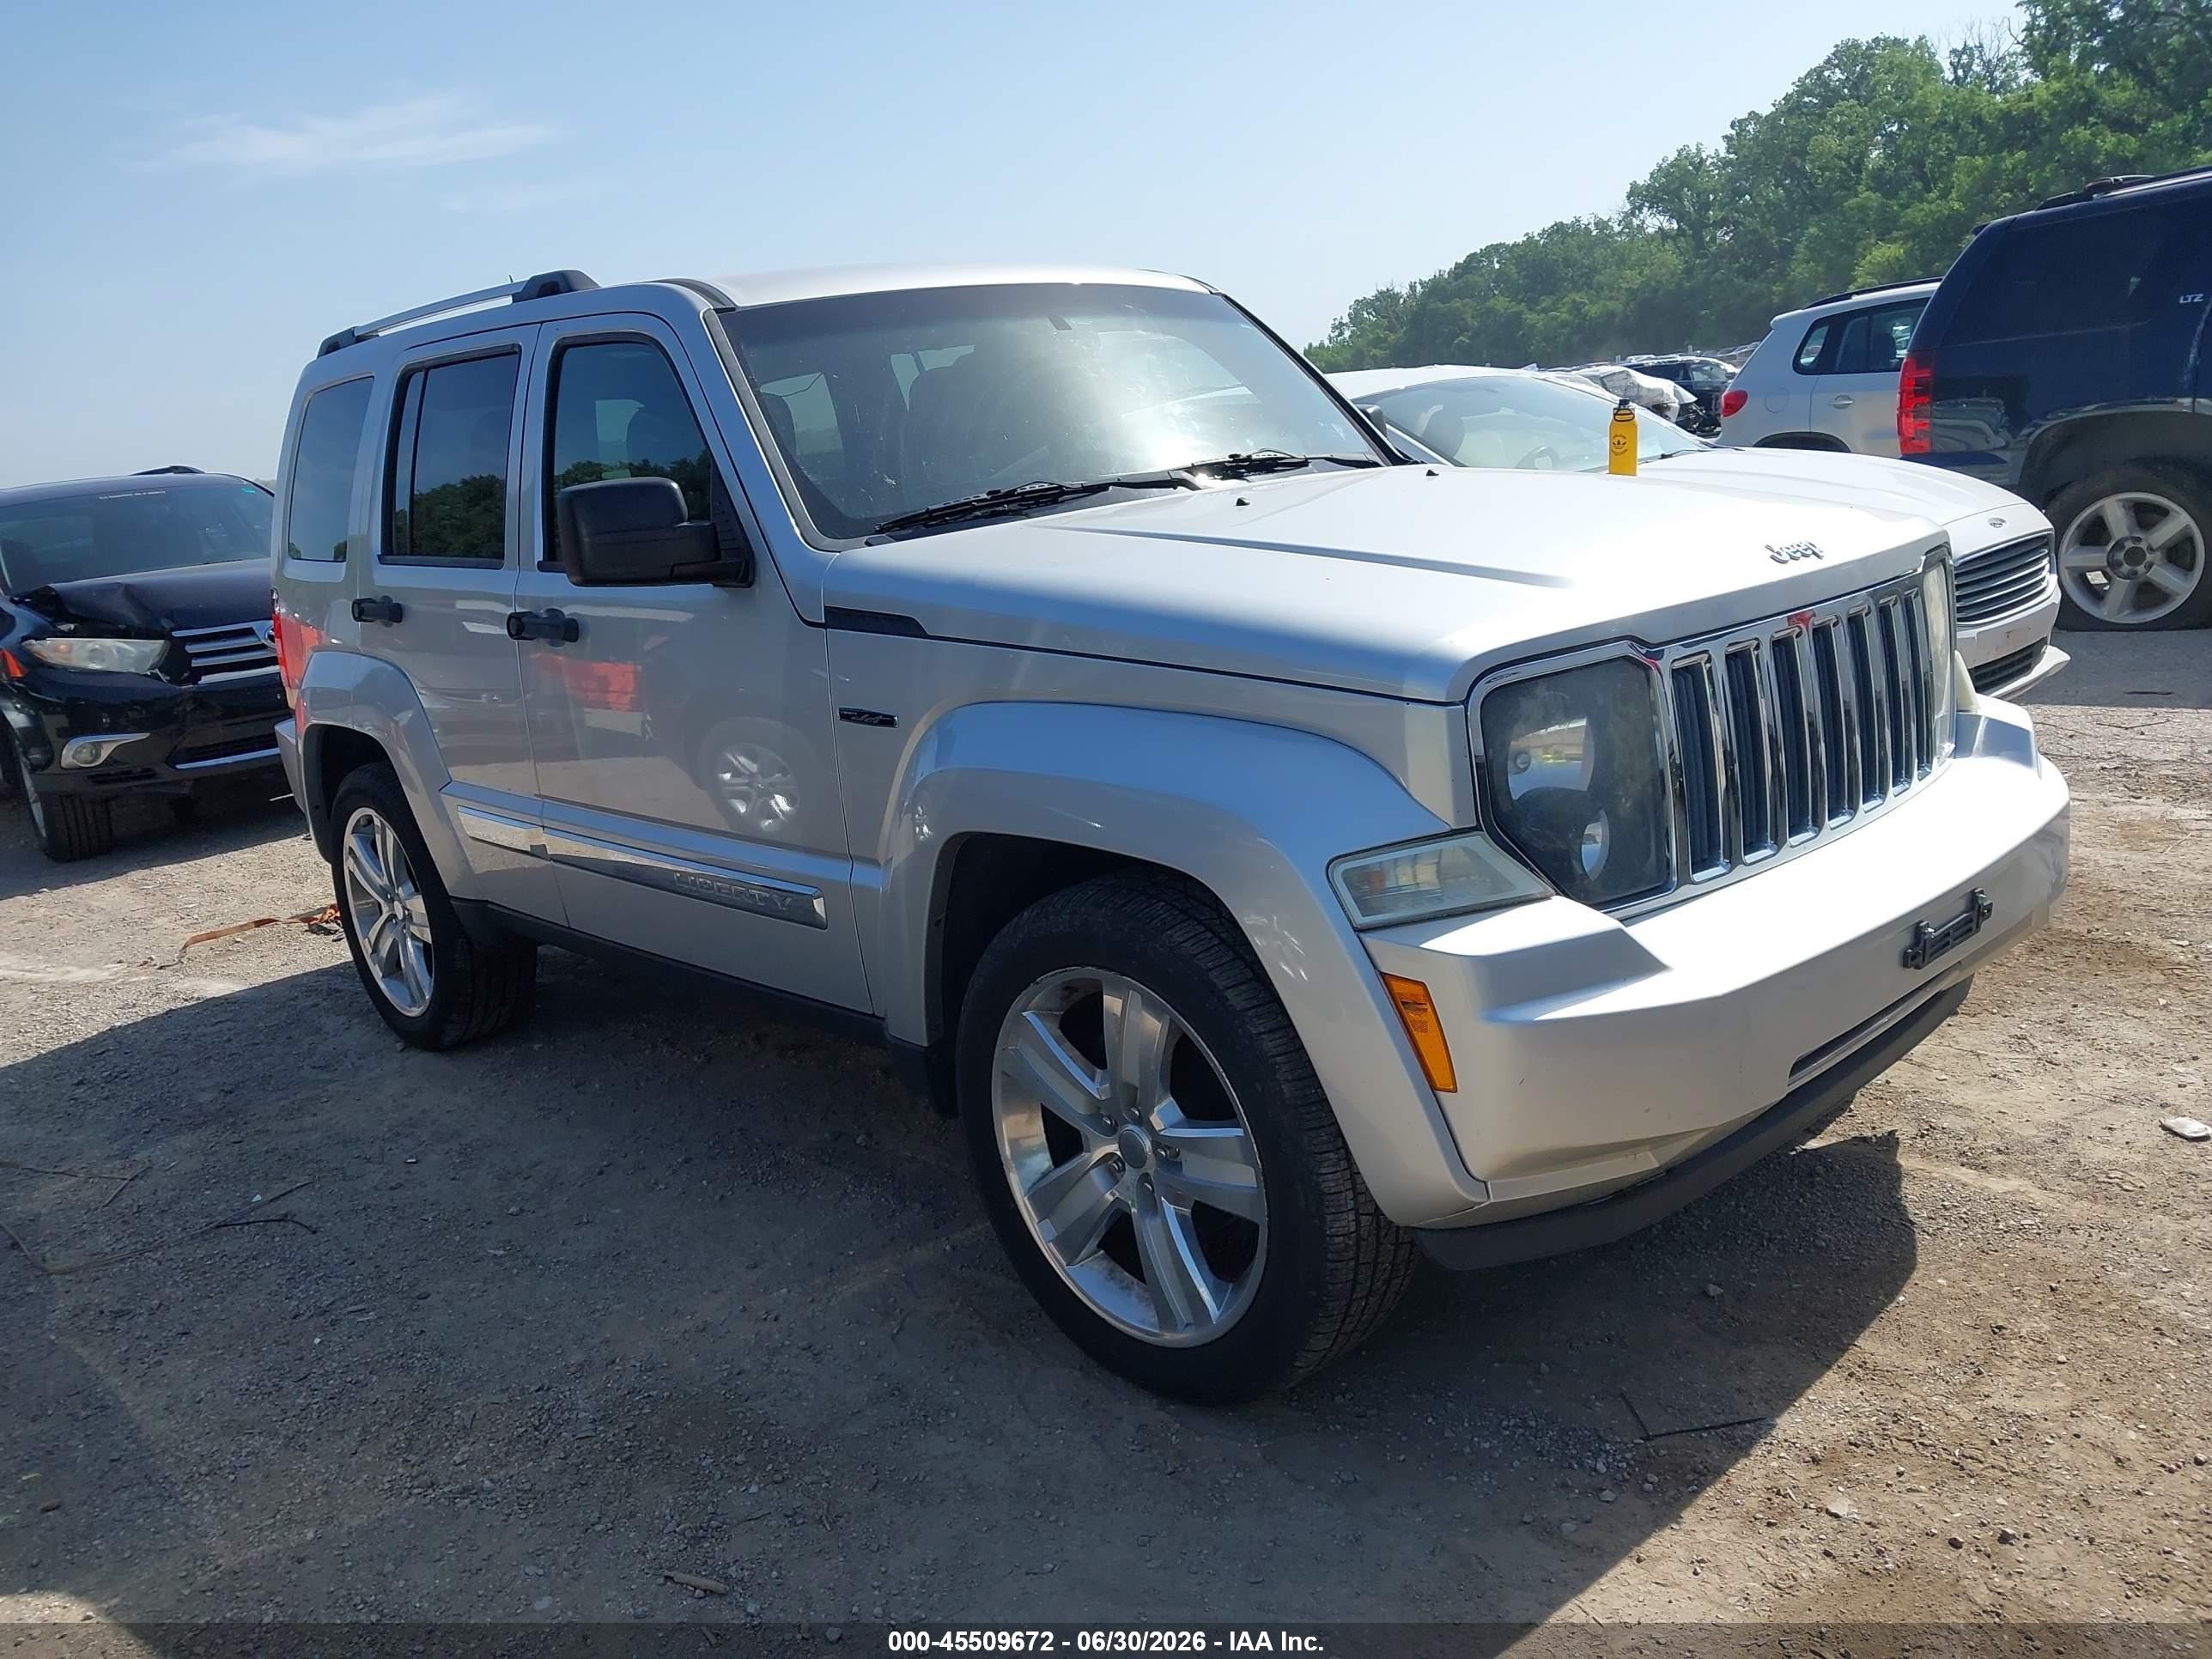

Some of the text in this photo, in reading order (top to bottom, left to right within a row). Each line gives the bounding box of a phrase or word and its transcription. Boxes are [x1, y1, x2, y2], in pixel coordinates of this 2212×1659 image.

[2179, 294, 2204, 304] LTZ
[1765, 541, 1824, 564] Jeep
[673, 872, 792, 910] LIBERTY
